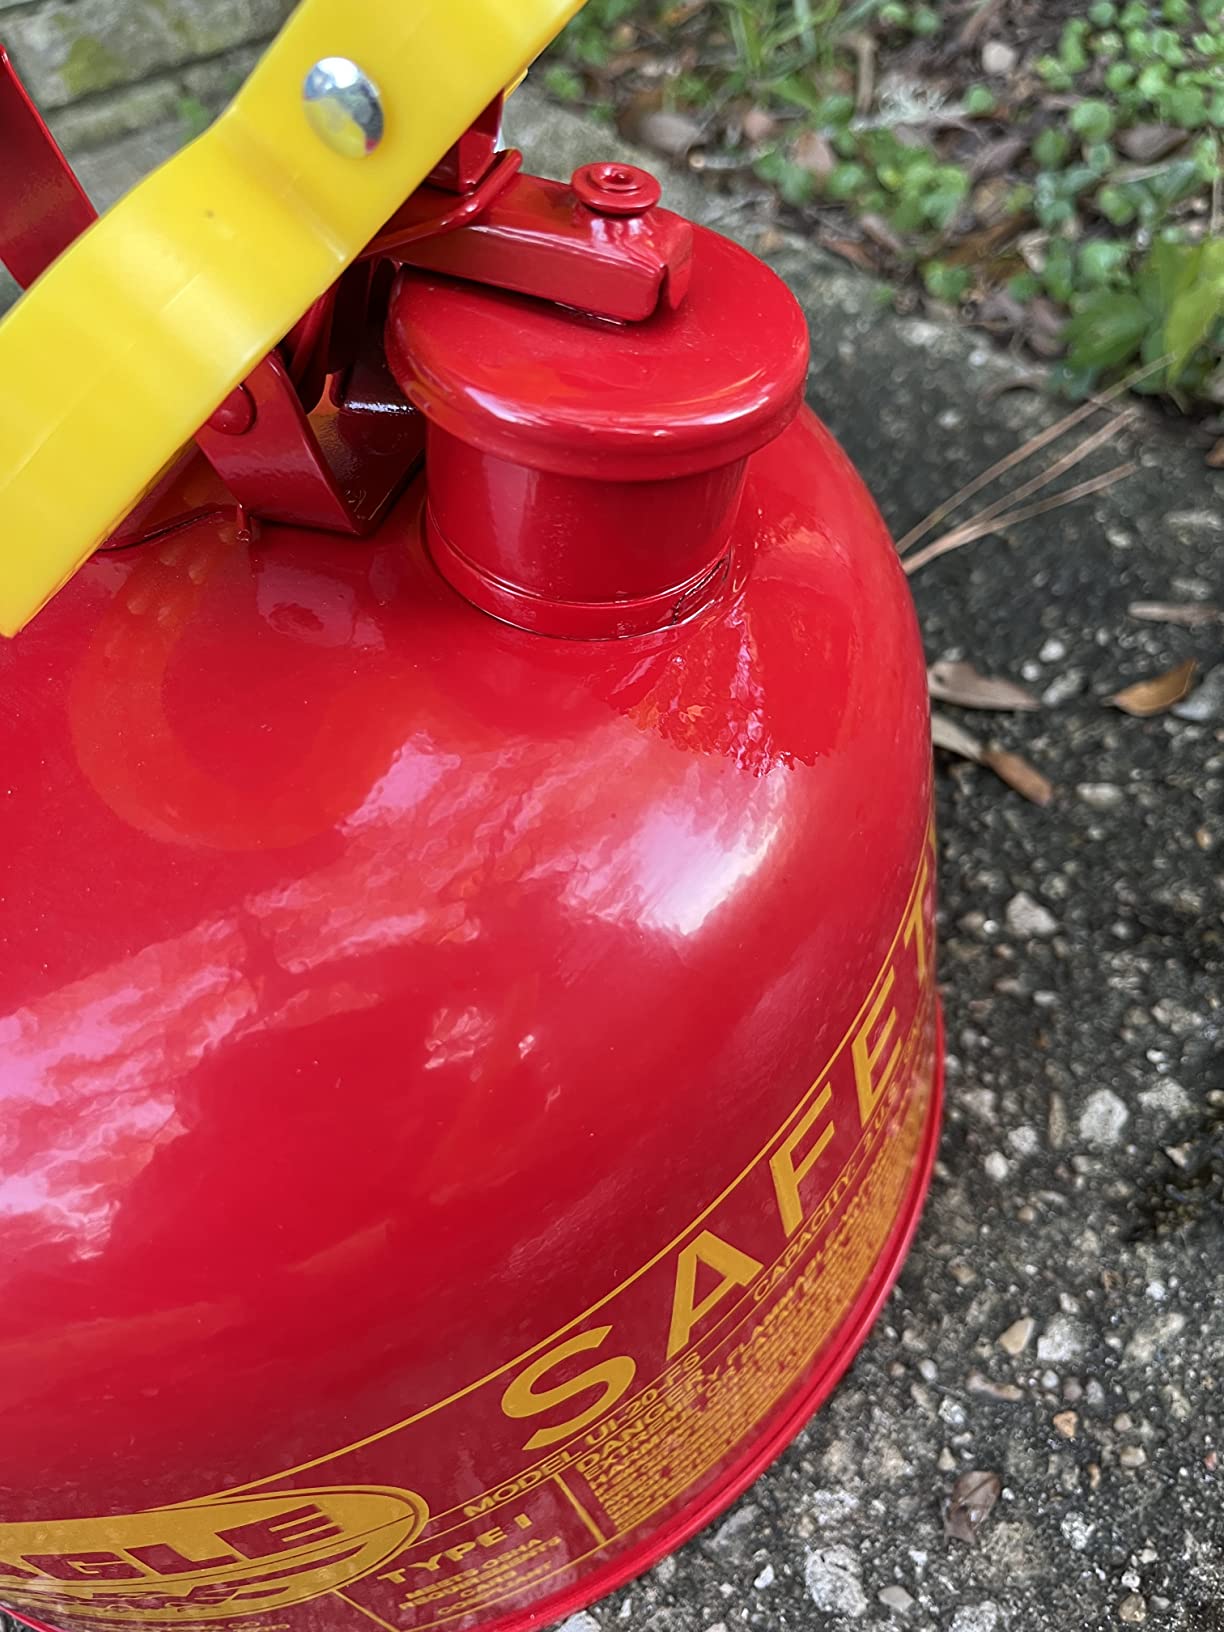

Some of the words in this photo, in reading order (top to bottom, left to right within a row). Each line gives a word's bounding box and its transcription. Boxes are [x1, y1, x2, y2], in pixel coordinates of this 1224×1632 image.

[501, 818, 937, 1451] SAFET
[754, 1162, 857, 1302] CAPACITY:
[463, 1450, 582, 1518] MODEL
[584, 1352, 700, 1446] UI-20-FS
[574, 1367, 705, 1474] DANGER
[583, 1363, 720, 1482] EXTREMELY
[588, 1405, 700, 1494] HARMFUL
[703, 1364, 736, 1398] OR
[0, 1503, 344, 1581] GLE
[376, 1526, 508, 1584] TYPE
[399, 1536, 562, 1610] REQUIREMENTS
[405, 1568, 479, 1600] MEETS
[482, 1538, 542, 1570] OSHA
